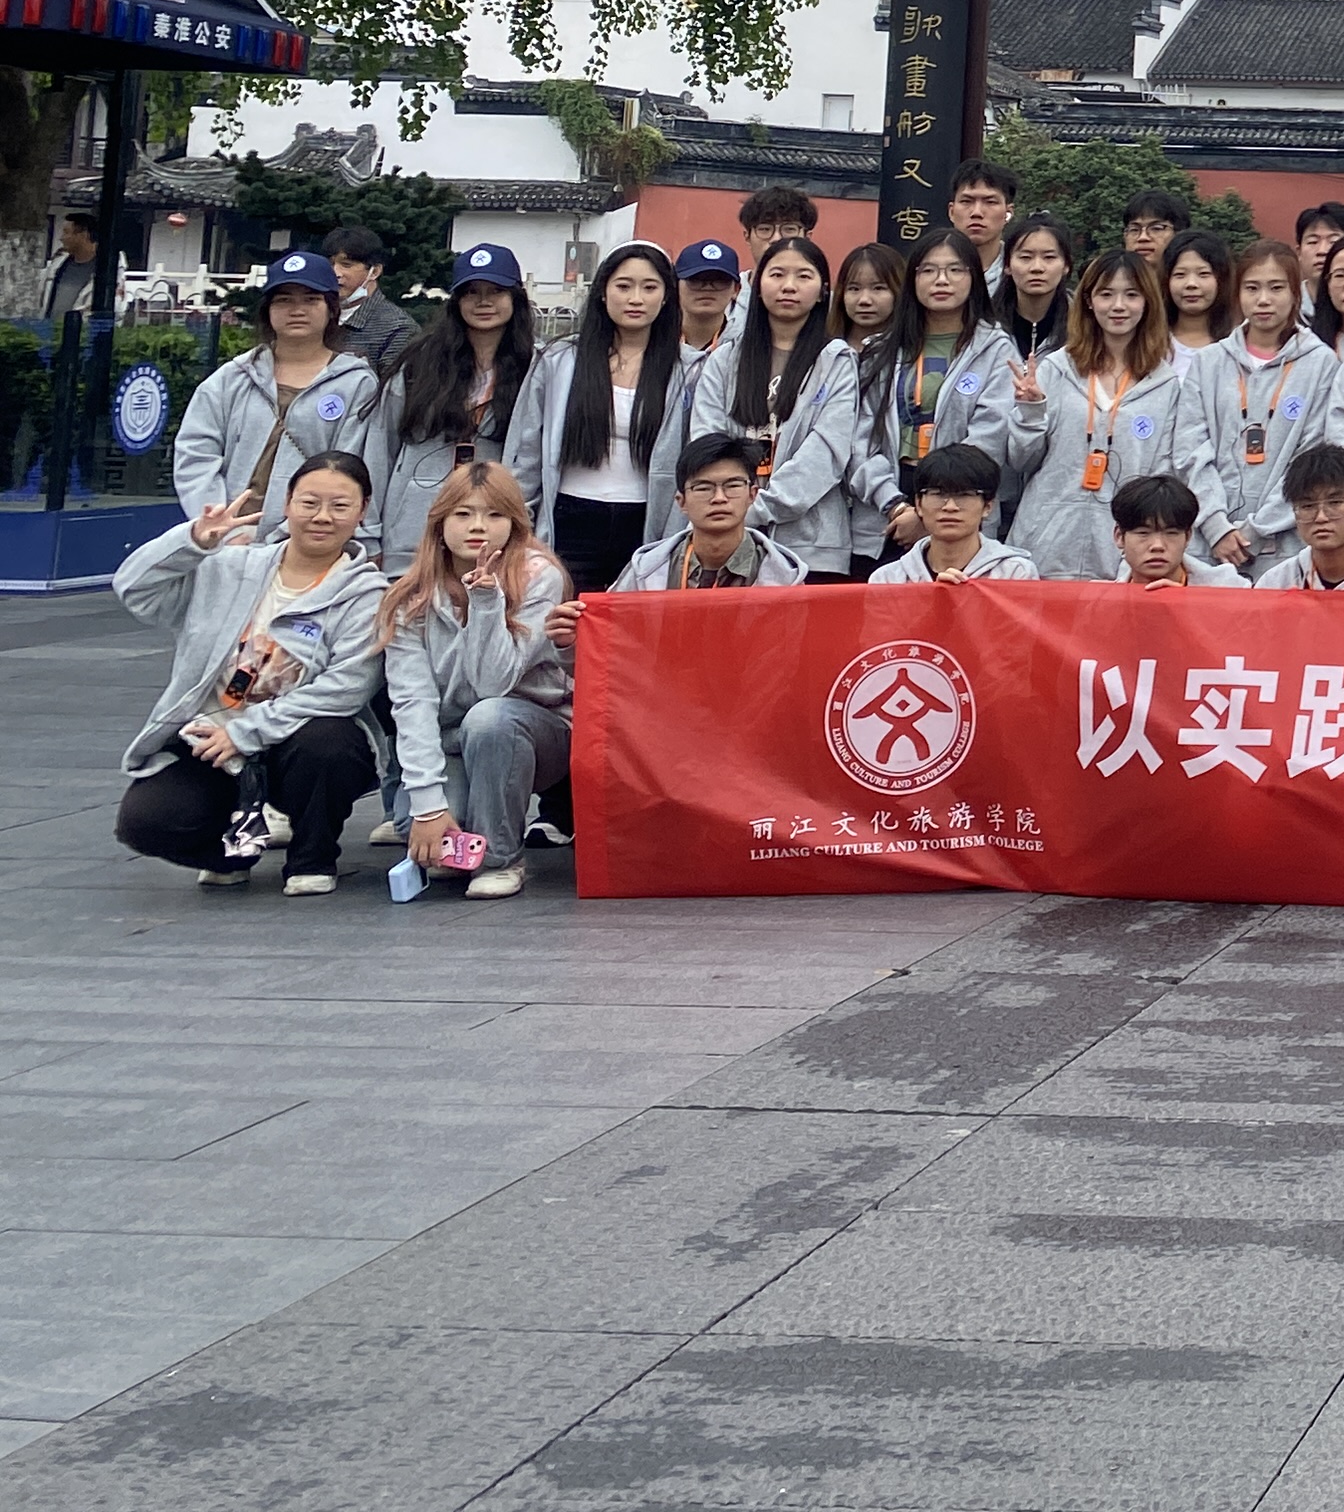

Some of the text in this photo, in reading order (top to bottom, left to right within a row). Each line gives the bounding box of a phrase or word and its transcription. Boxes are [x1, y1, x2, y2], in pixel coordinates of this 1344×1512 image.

[153, 12, 231, 50] 秦淮公安
[891, 779, 911, 788] AND
[749, 801, 1042, 841] 丽江文化旅游学院
[750, 834, 1045, 861] LIJIANG CULTURE AND TOURISM COLLEGE
